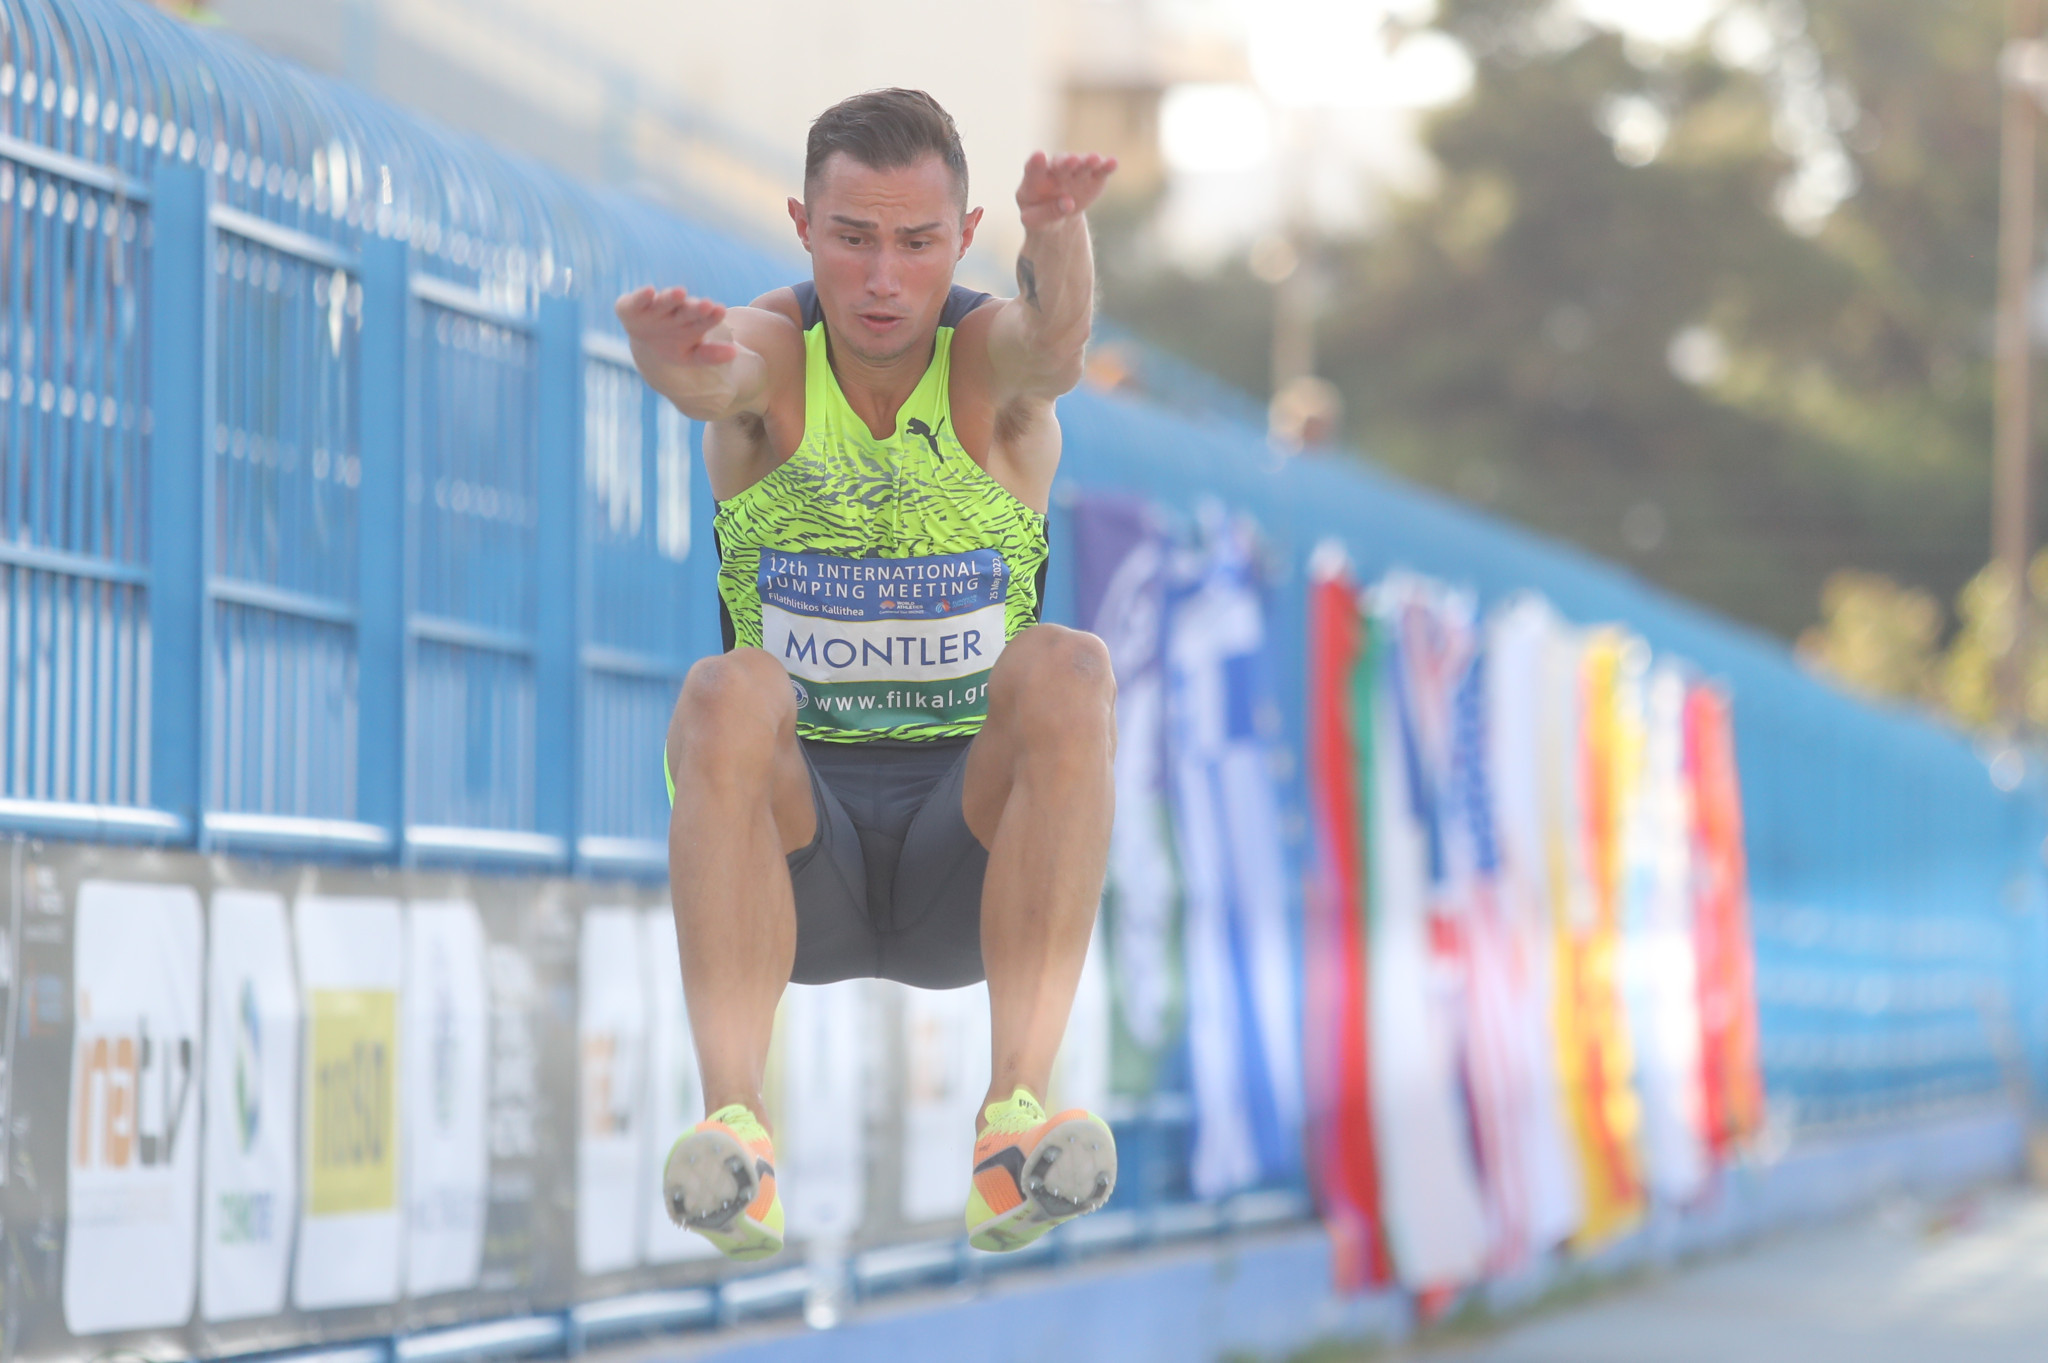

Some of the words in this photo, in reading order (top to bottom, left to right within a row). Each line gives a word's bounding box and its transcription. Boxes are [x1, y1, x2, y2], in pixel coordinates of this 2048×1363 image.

[770, 556, 808, 577] 12th
[817, 560, 981, 581] INTERNATIONAL
[992, 557, 1002, 577] 2022
[766, 575, 865, 599] JUMPING
[878, 578, 979, 598] MEETING
[990, 591, 999, 600] 25
[768, 593, 820, 612] Filathlitikos
[822, 604, 864, 616] Kallithea
[785, 629, 983, 669] MONTLER
[814, 682, 989, 712] www.filkal.gr
